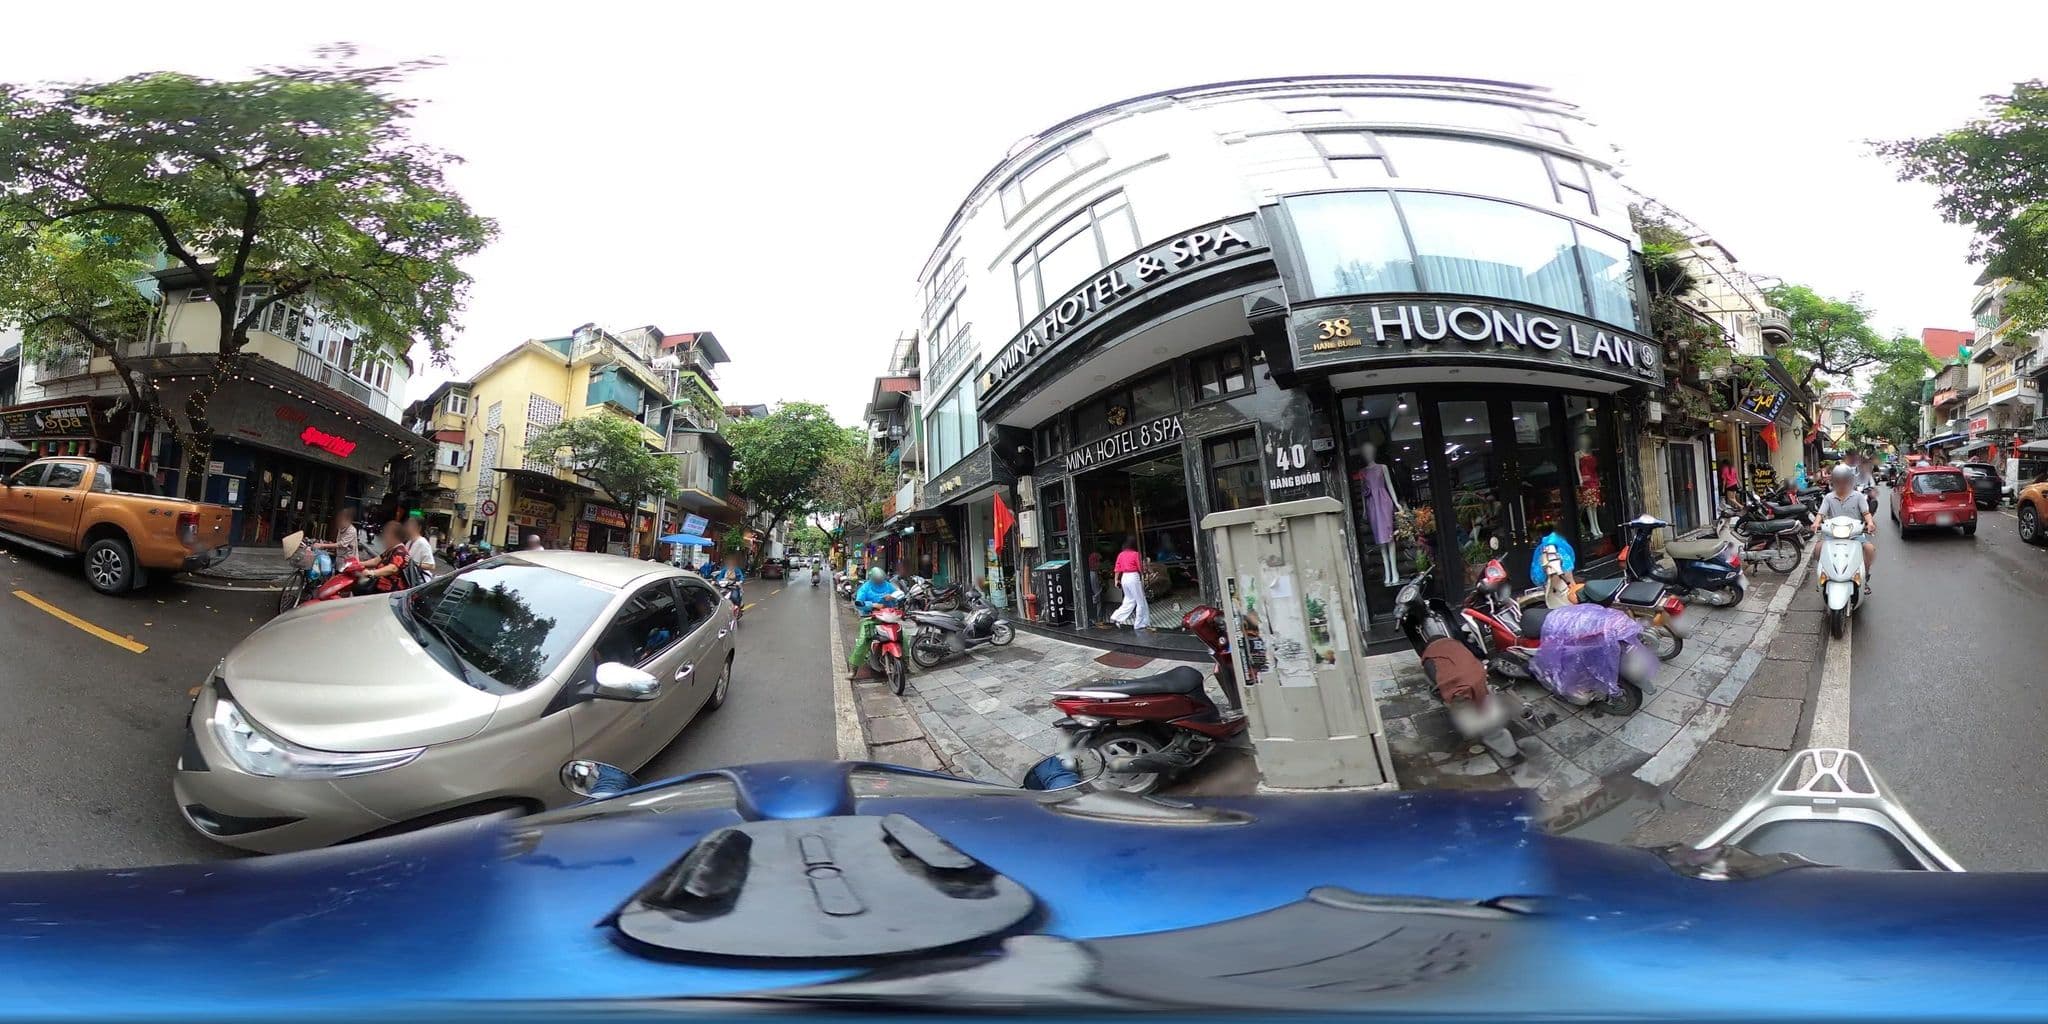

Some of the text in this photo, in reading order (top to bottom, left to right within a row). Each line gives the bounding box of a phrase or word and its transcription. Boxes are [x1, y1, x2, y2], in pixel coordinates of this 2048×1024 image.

[1000, 225, 1249, 377] MINA HOTEL & SPA
[1318, 319, 1352, 339] 38
[1371, 306, 1635, 366] HUONG LAN
[45, 415, 82, 433] Spa
[1066, 416, 1184, 473] MINA HOTEL & SPA
[1276, 444, 1306, 470] 40
[1755, 469, 1771, 478] Spa
[1047, 574, 1056, 618] MASSAGE
[1056, 574, 1064, 616] FOOT
